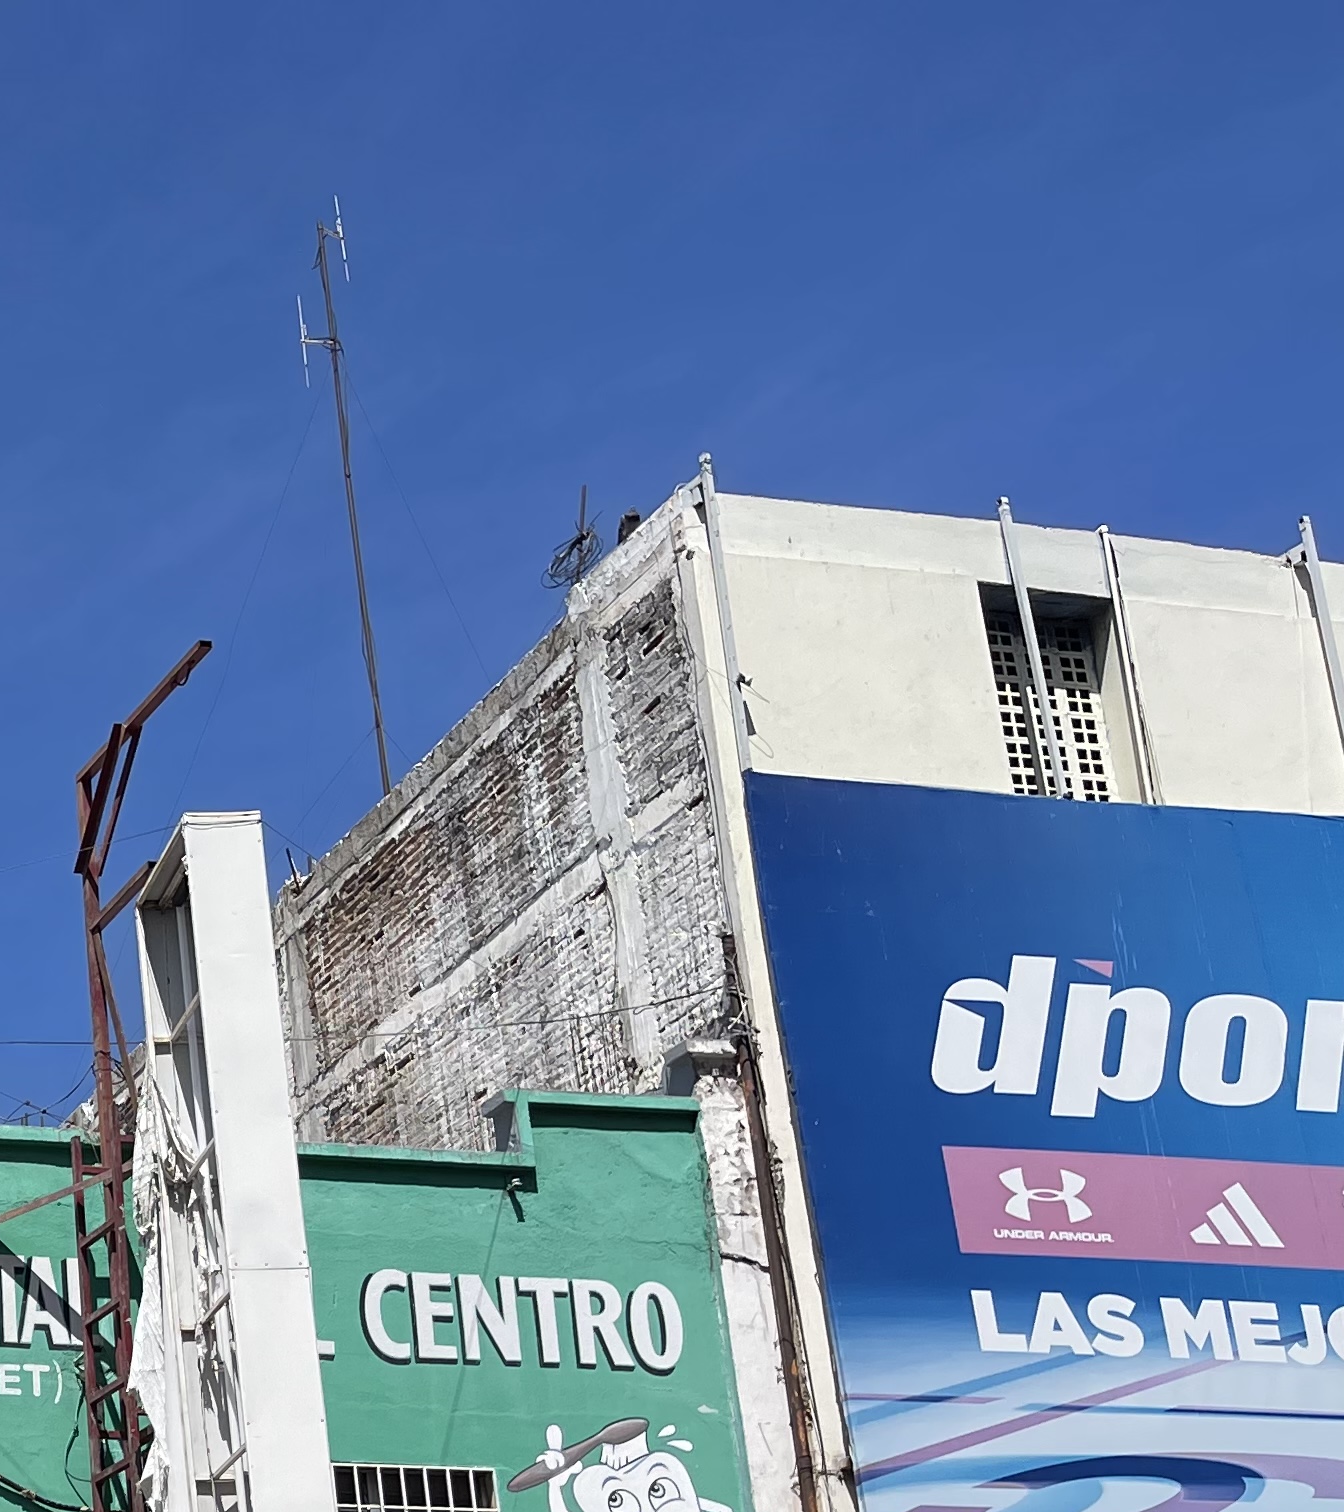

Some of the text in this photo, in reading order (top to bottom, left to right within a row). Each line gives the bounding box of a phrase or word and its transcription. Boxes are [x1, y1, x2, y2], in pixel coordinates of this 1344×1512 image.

[993, 1228, 1045, 1241] UNDER
[361, 1269, 683, 1375] CENTRO
[970, 1289, 1344, 1366] LAS MEJ
